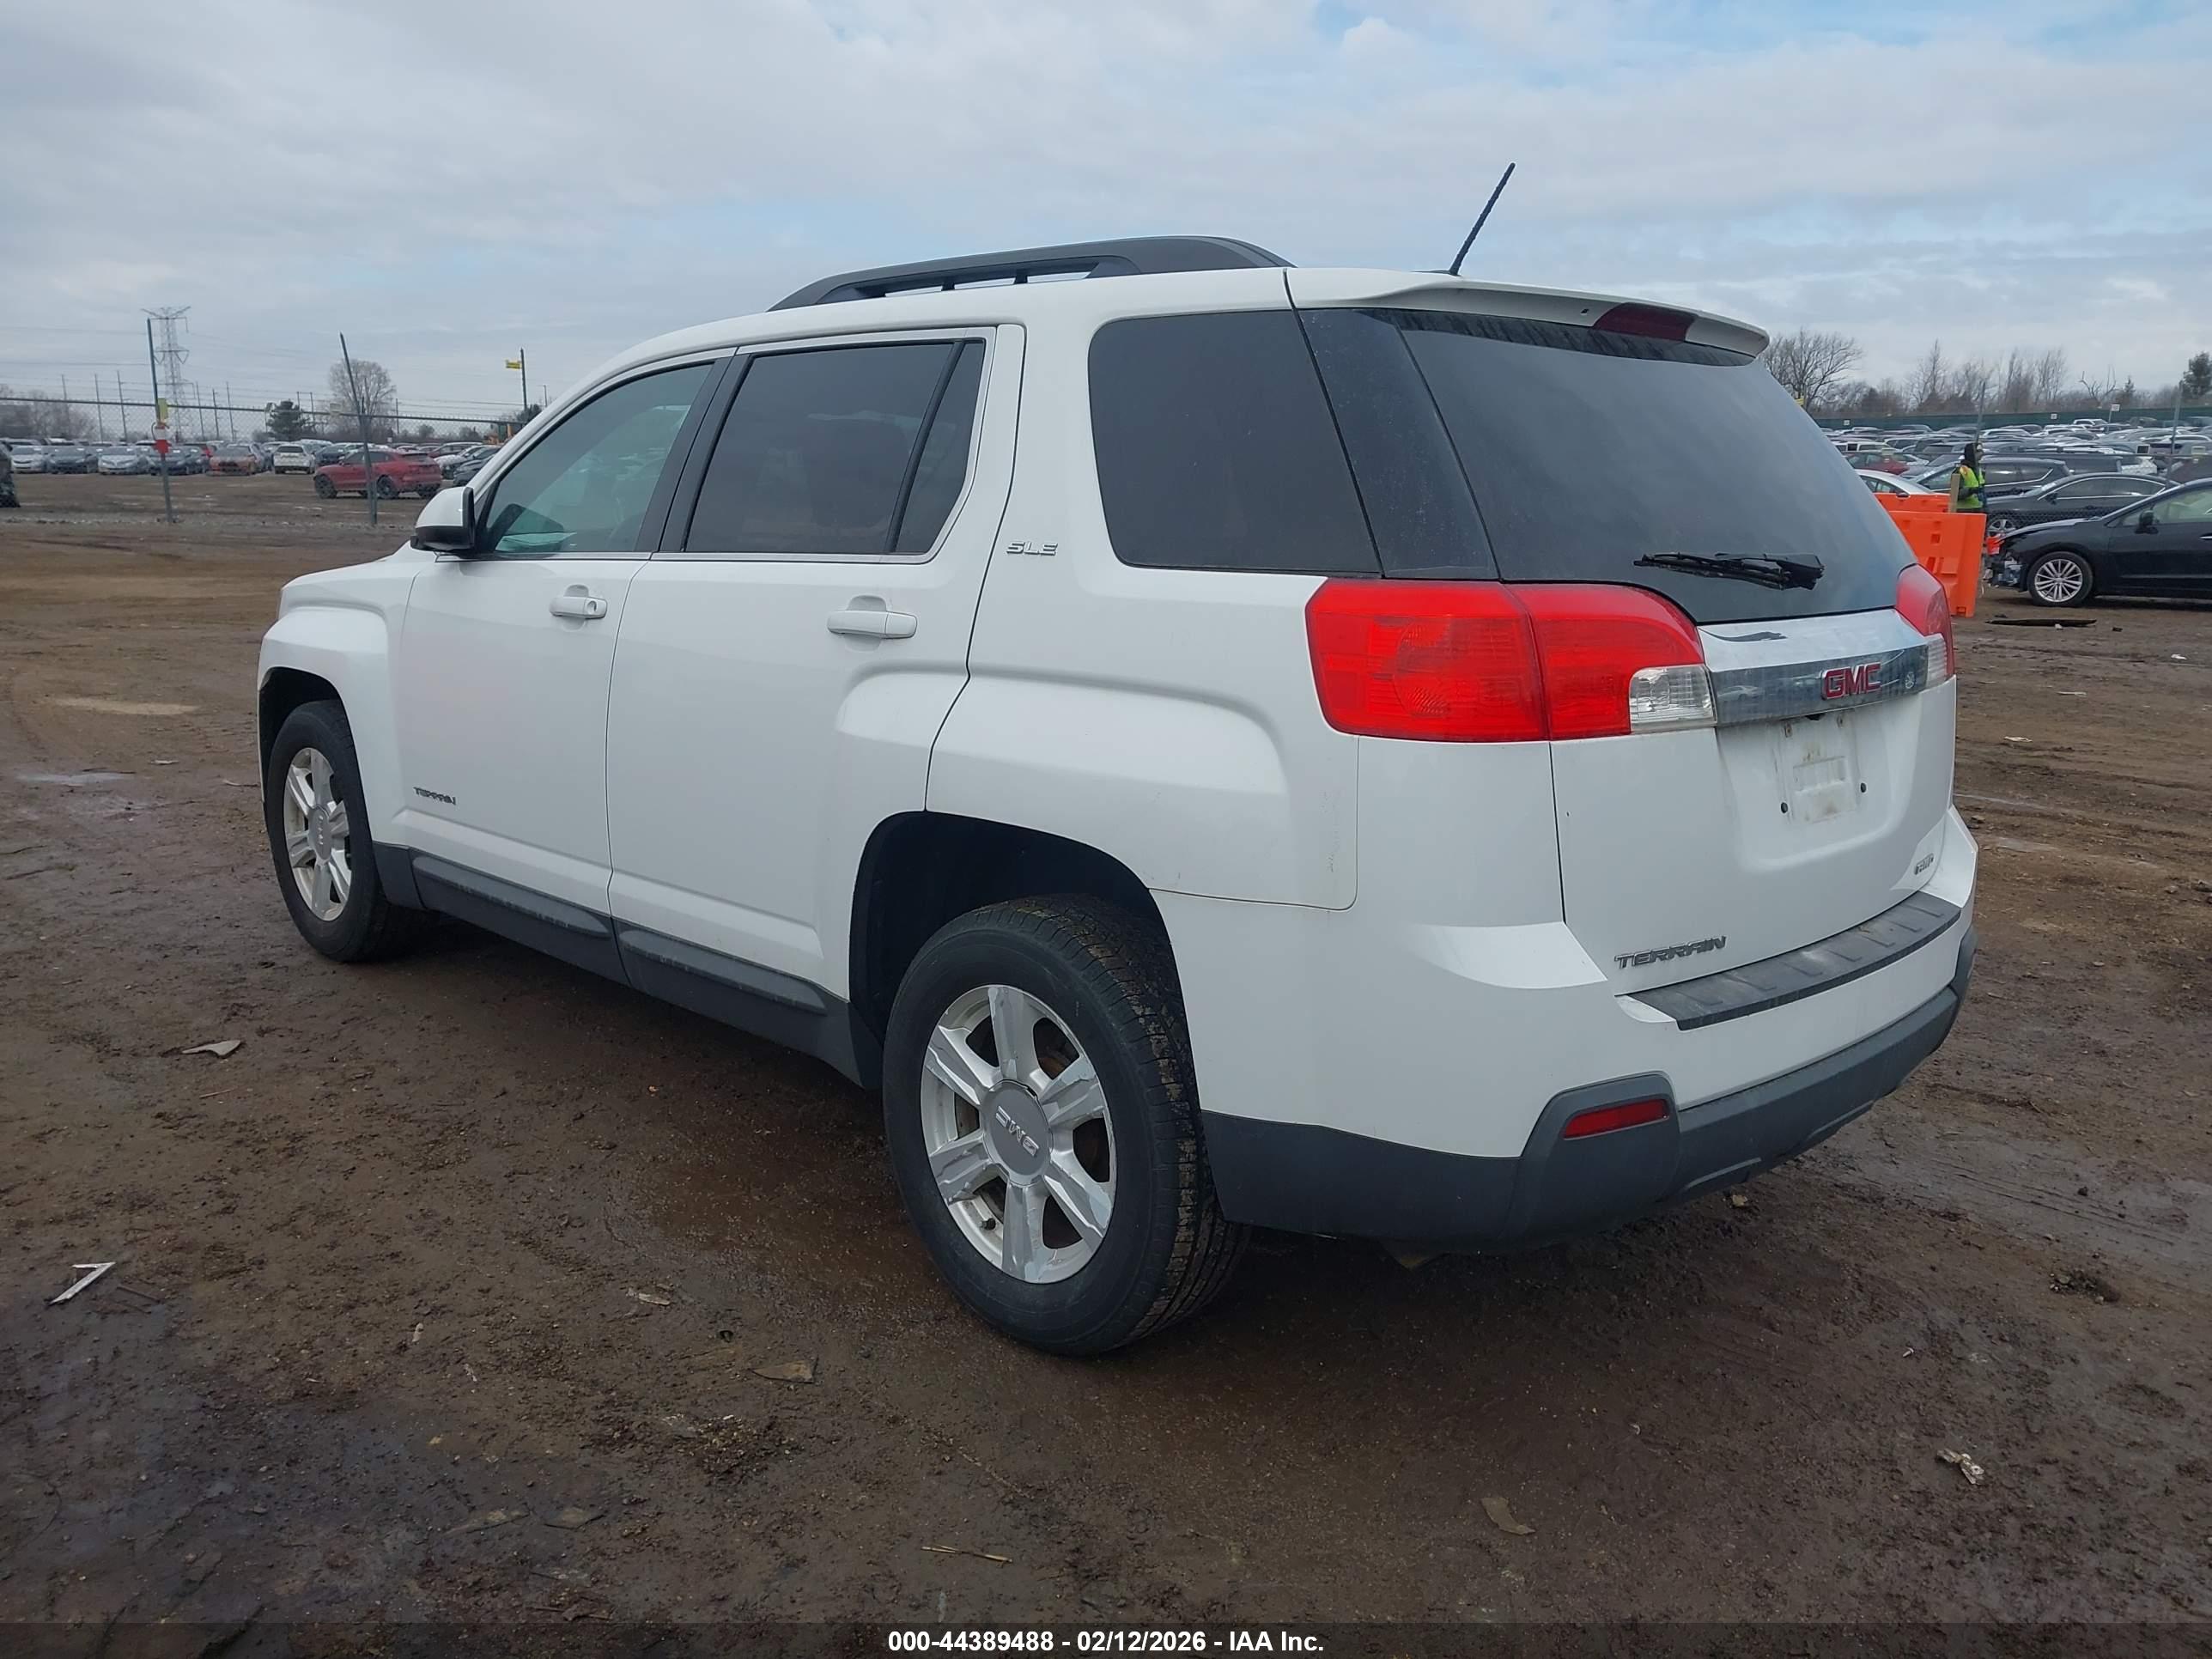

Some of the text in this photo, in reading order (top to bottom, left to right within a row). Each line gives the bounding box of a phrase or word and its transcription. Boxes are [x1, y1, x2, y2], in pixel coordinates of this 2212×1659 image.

[1006, 541, 1058, 556] SLE
[1821, 662, 1881, 700] GMC
[1614, 935, 1726, 969] TERRAIN
[995, 1105, 1040, 1157] GMC
